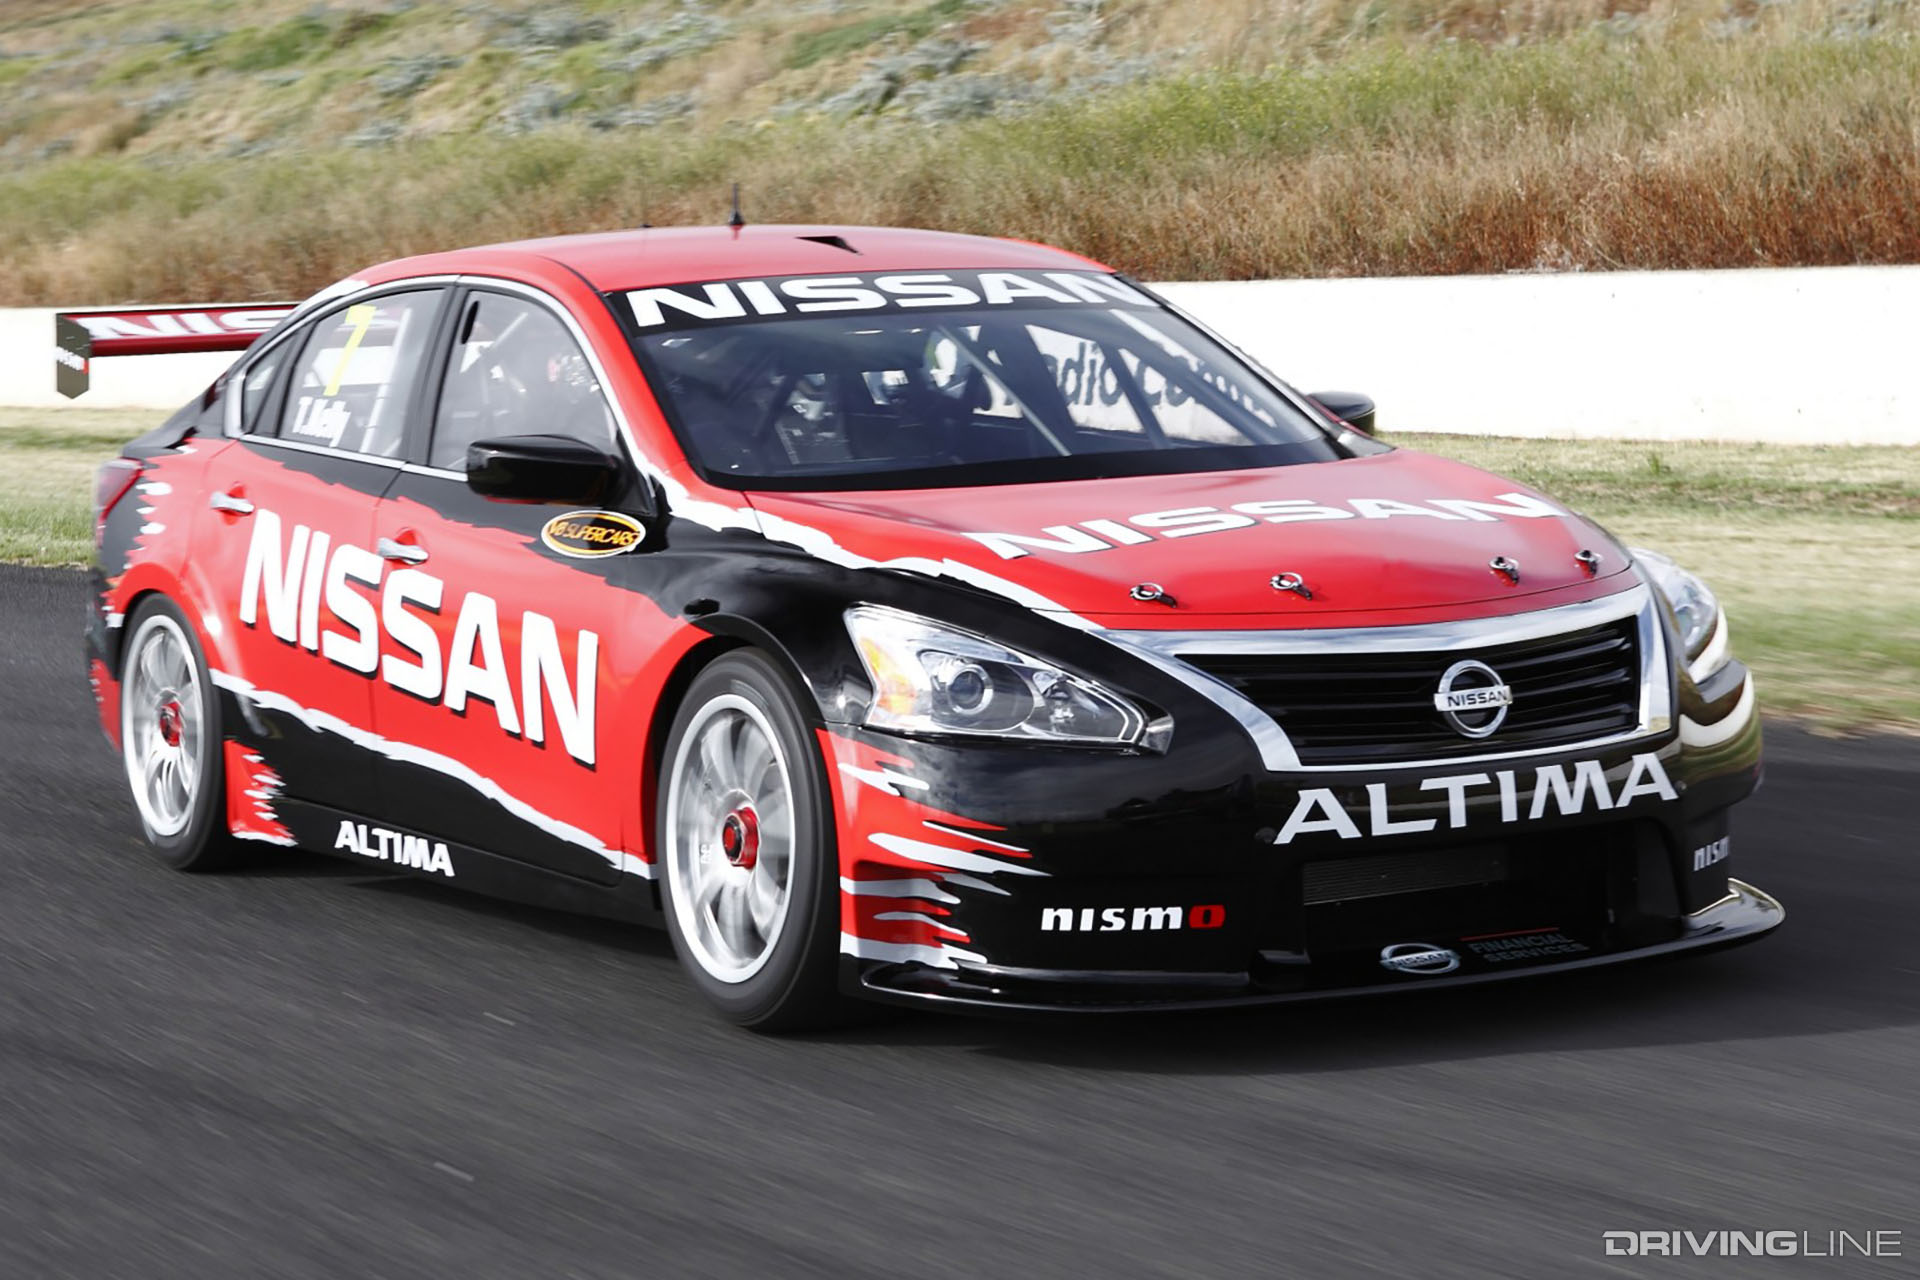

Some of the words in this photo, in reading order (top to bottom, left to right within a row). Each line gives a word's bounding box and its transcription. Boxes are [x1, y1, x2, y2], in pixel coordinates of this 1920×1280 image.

[624, 272, 1163, 328] NISSAN
[322, 304, 377, 397] 7
[961, 492, 1566, 560] NISSAN
[239, 508, 599, 768] NISSAN
[1447, 690, 1508, 708] NISSAN
[1272, 753, 1679, 845] ALTIMA
[334, 820, 455, 877] ALTIMA
[1041, 904, 1227, 932] nismo
[1468, 933, 1576, 954] FINANCIAL
[1482, 943, 1590, 963] SERVICES
